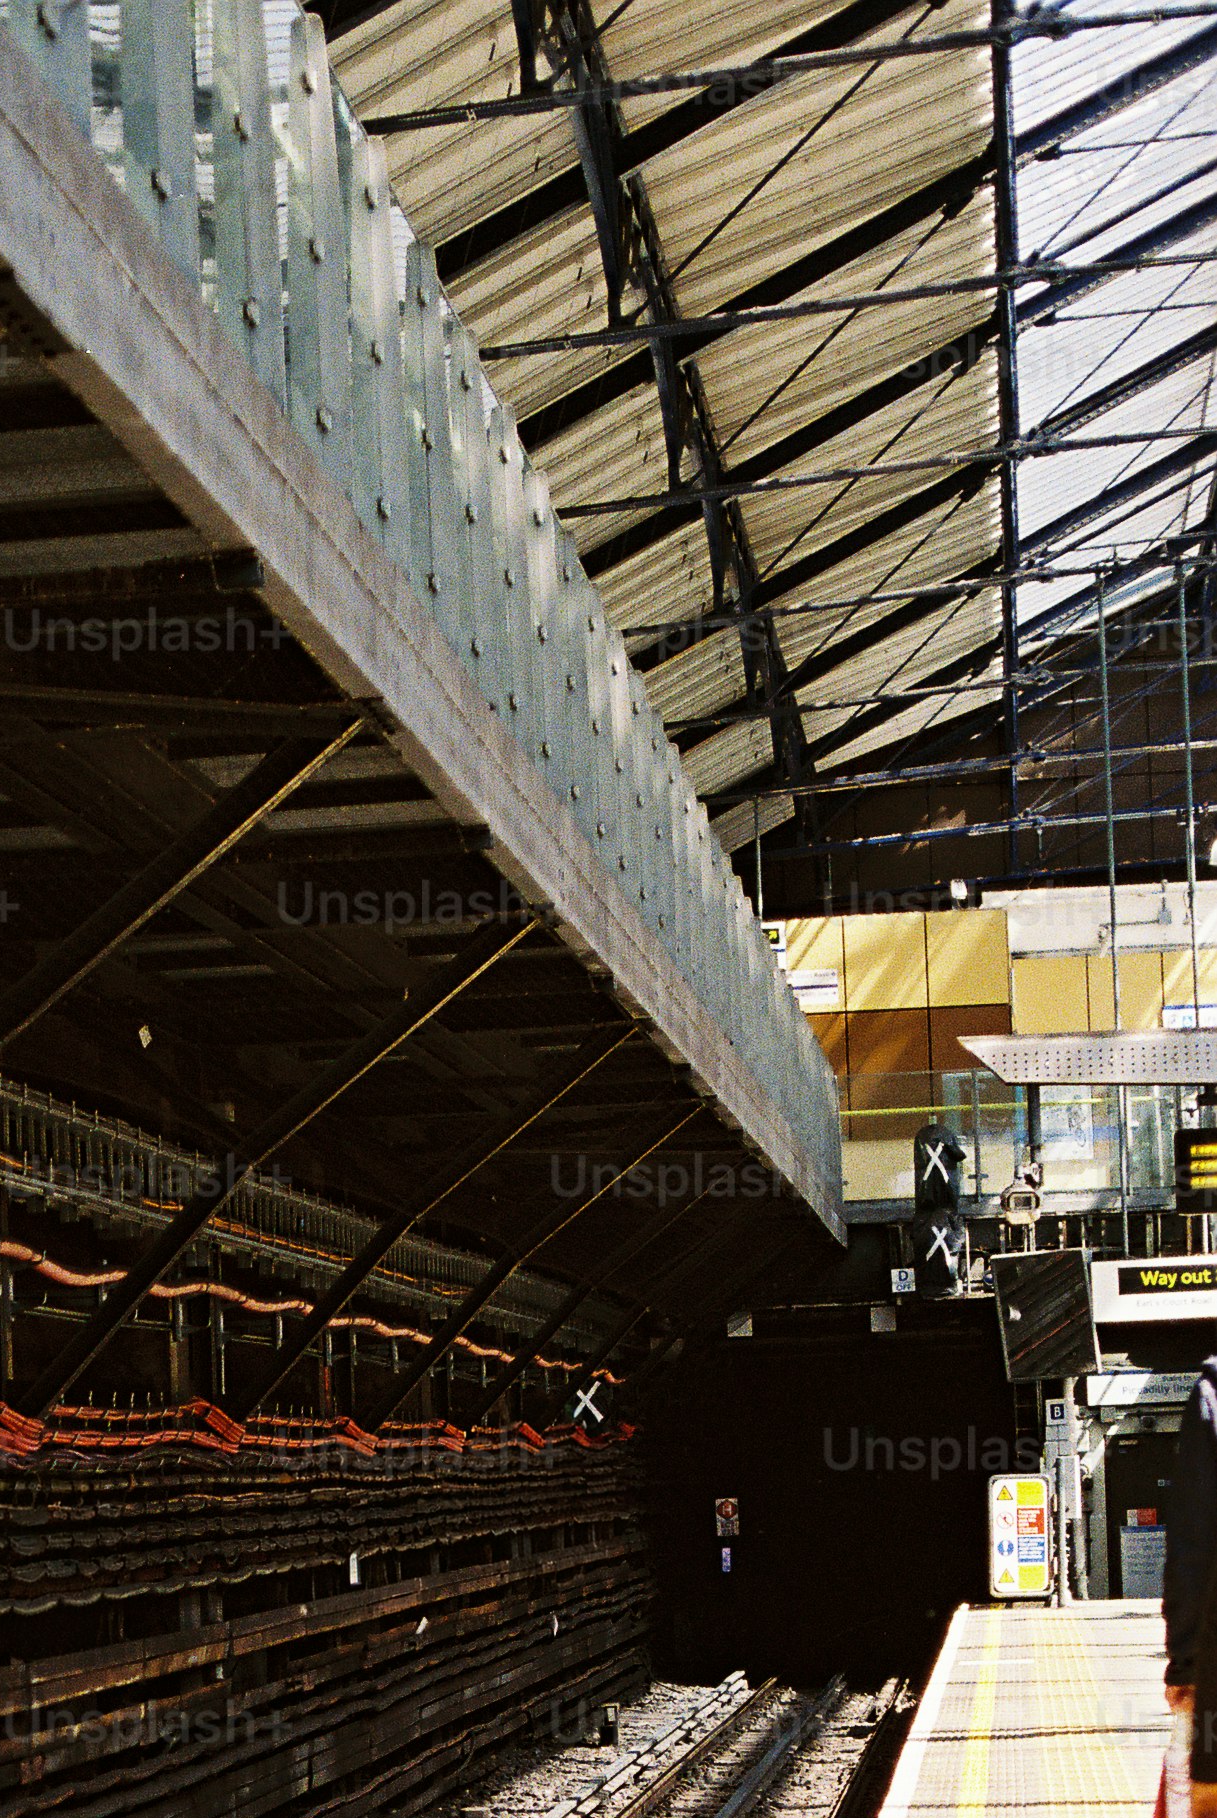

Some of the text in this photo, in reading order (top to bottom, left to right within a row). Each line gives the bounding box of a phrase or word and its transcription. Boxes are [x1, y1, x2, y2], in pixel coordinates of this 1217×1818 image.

[898, 1270, 909, 1282] D
[1140, 1268, 1212, 1289] Way out
[1054, 1406, 1062, 1418] B
